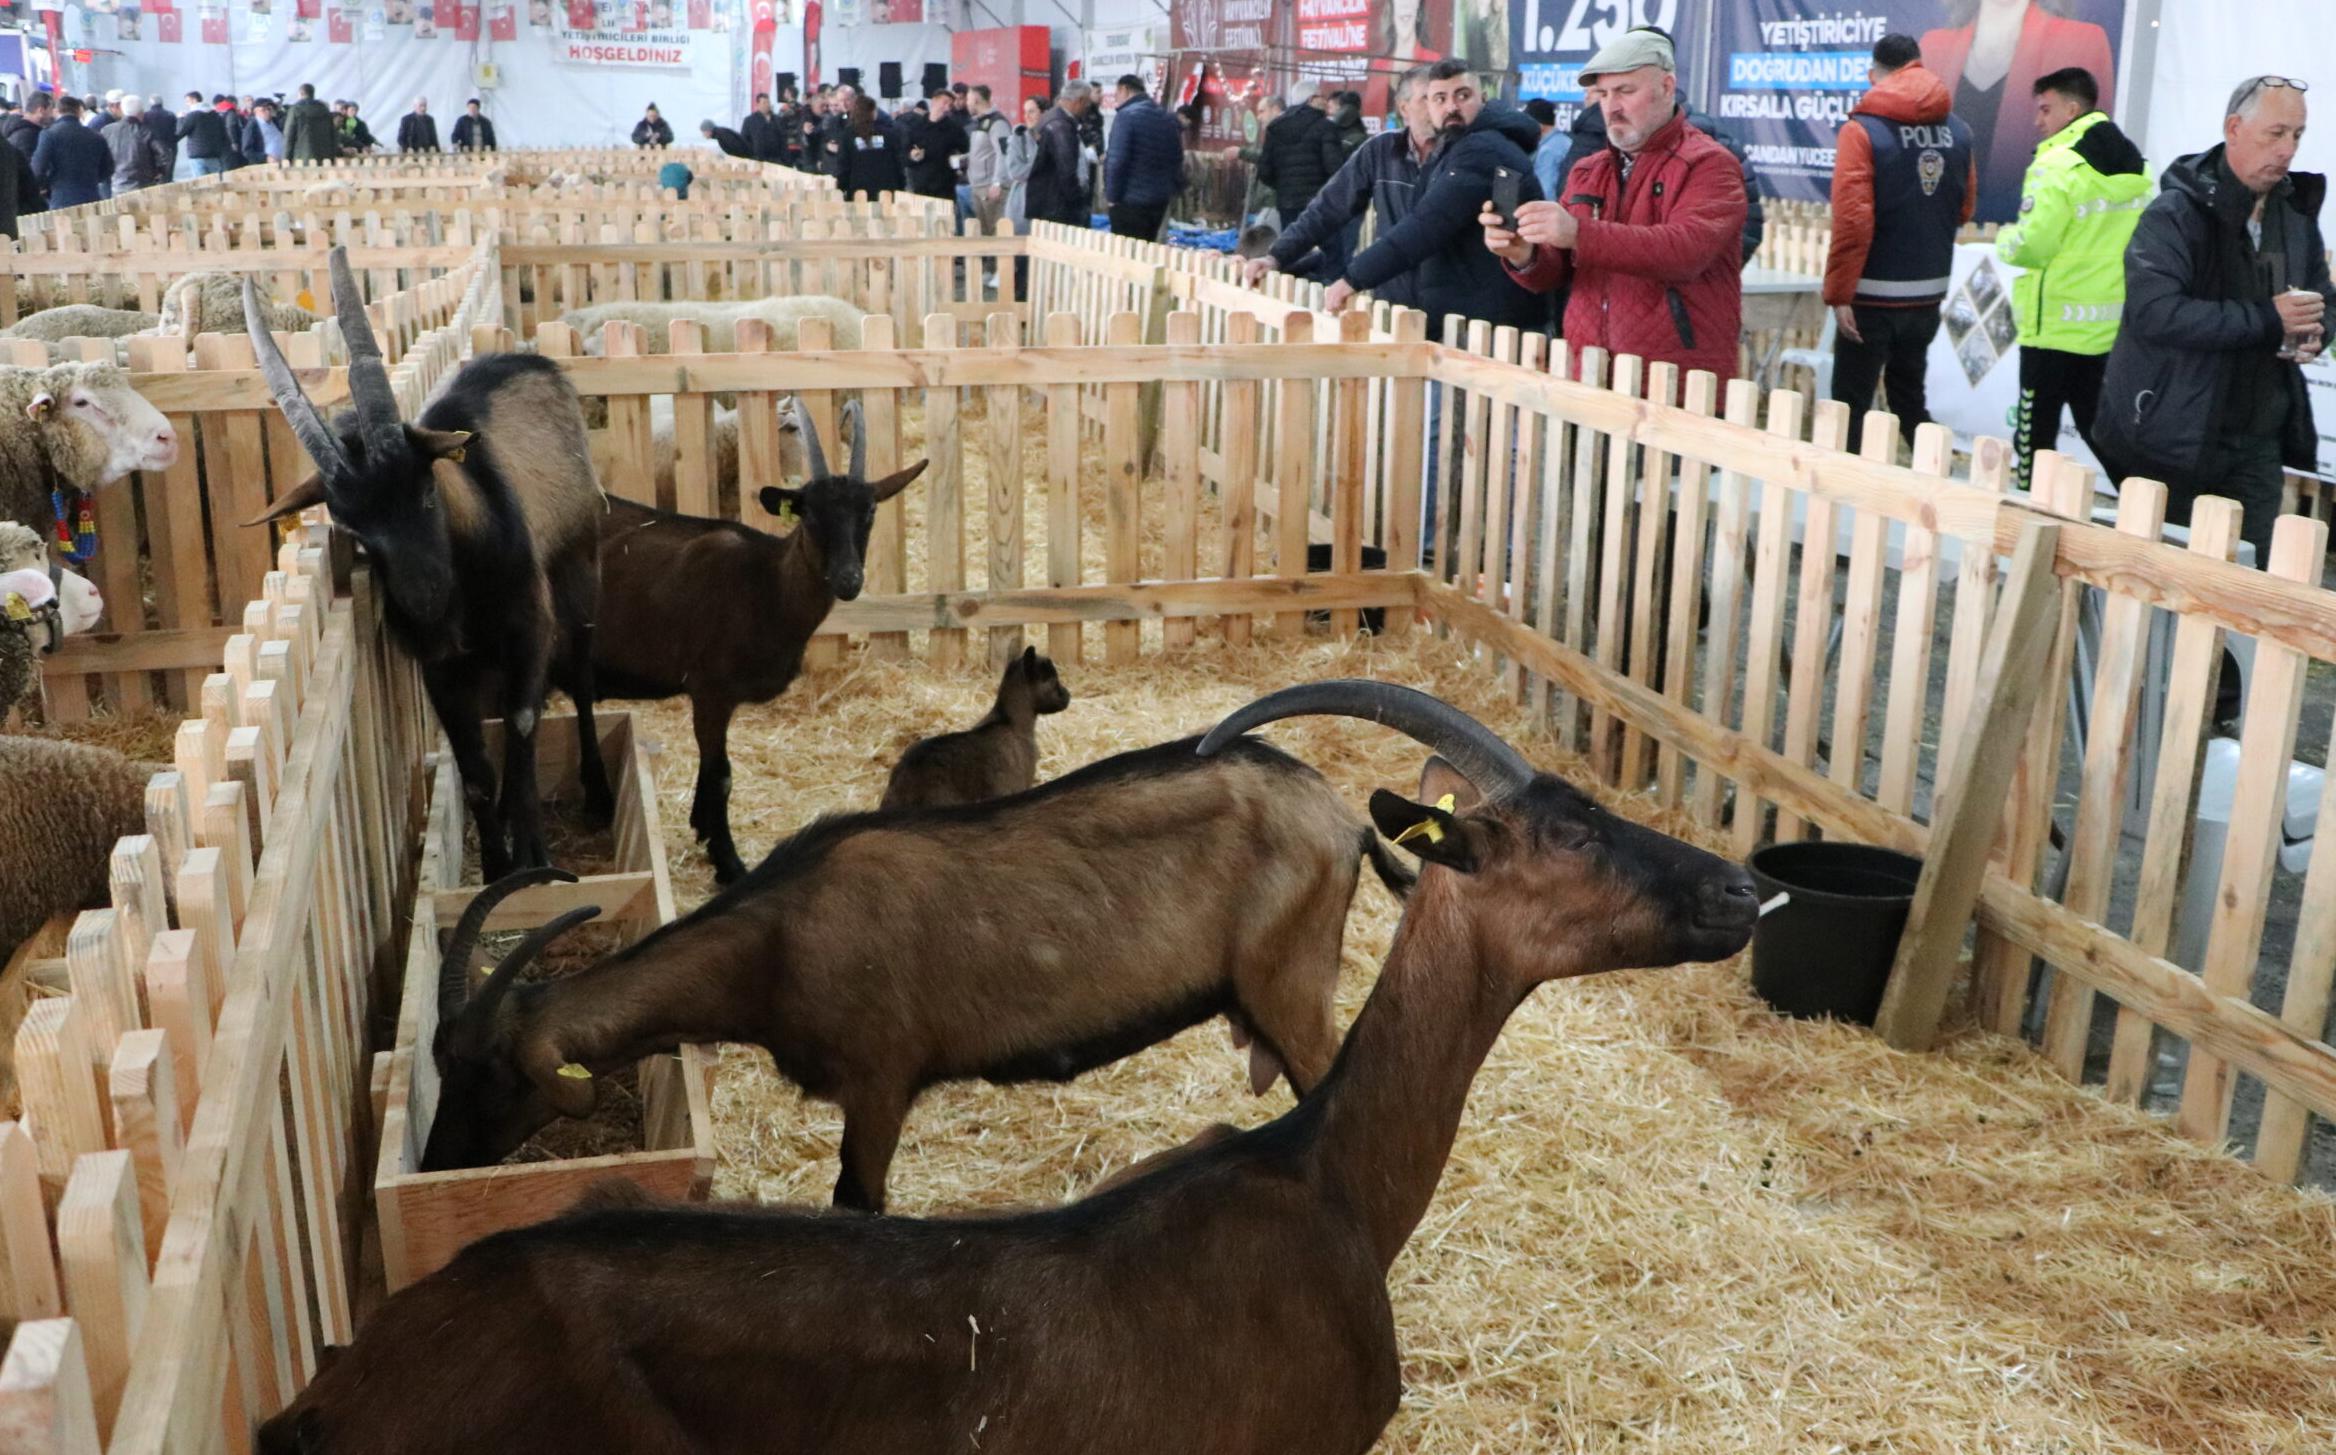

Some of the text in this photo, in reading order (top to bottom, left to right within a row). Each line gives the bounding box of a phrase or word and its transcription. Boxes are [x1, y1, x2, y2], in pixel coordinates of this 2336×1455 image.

[1524, 0, 1677, 52] 1.250
[1760, 11, 1887, 51] YETİŞTİRİCİYE
[1733, 54, 1836, 82] DOĞRUDAN
[1720, 94, 1793, 119] KIRSALA
